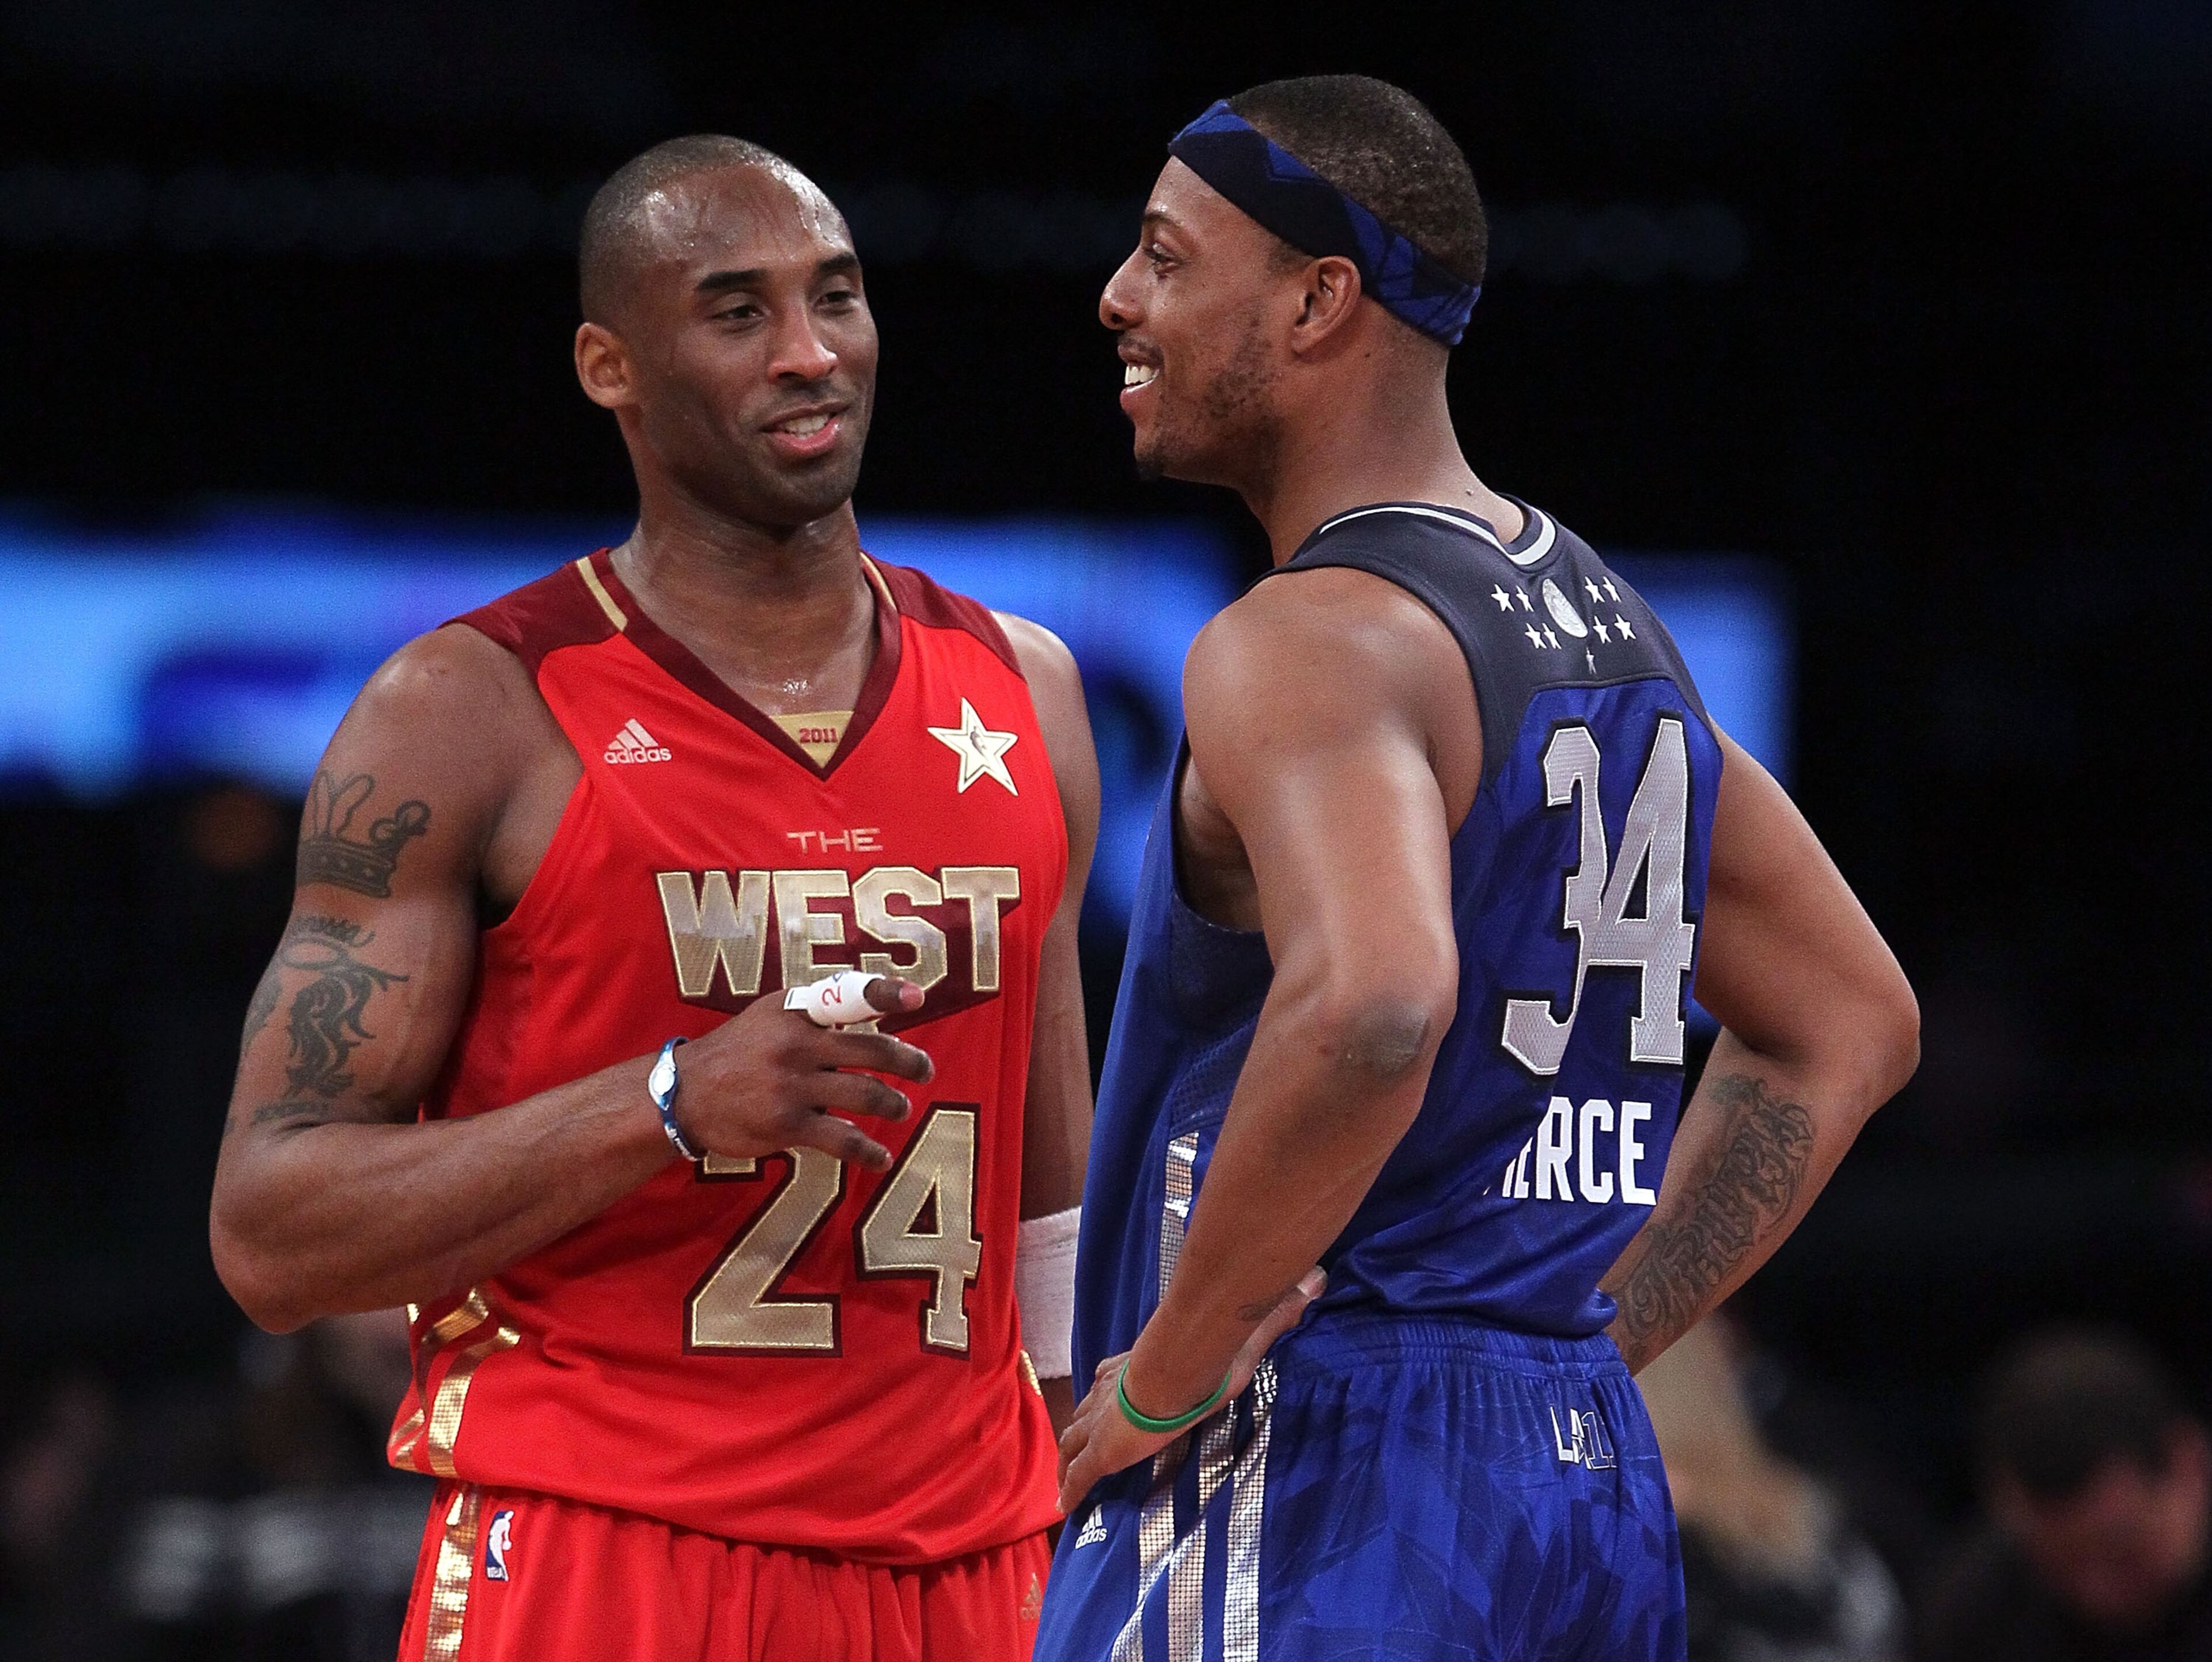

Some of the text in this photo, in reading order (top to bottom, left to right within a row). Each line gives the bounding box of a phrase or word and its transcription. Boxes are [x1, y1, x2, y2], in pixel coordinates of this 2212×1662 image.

[604, 748, 672, 764] adidas
[799, 727, 838, 743] 2011
[787, 828, 883, 853] THE
[656, 866, 1021, 998] WEST
[1502, 718, 1695, 1075] 34
[691, 1109, 983, 1352] 24
